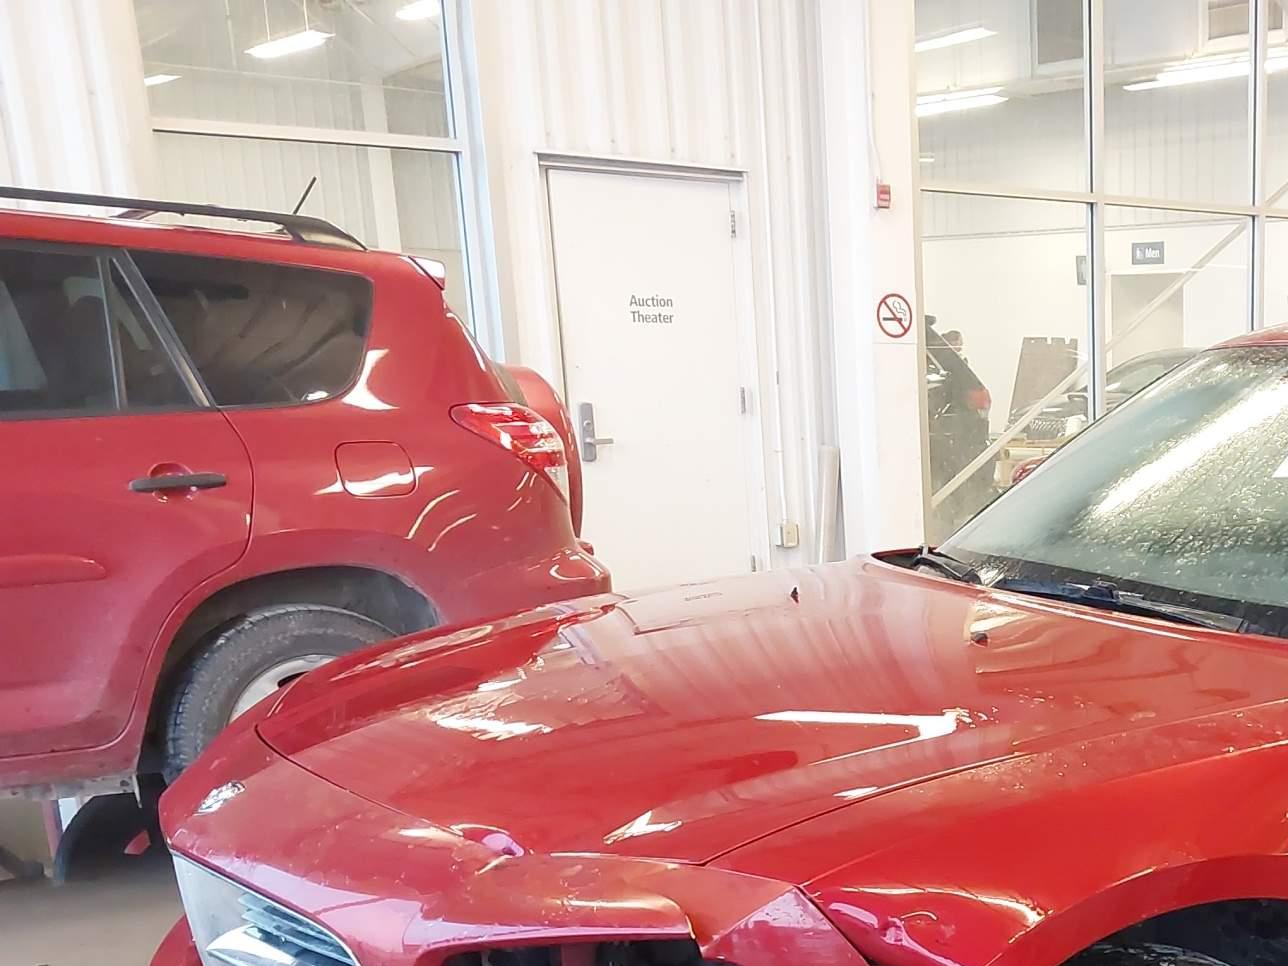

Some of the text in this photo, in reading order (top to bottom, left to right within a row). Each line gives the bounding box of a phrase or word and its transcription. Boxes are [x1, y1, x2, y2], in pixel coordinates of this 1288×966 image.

[1145, 247, 1161, 258] Men
[629, 294, 674, 308] Auction
[630, 310, 674, 324] Theater
